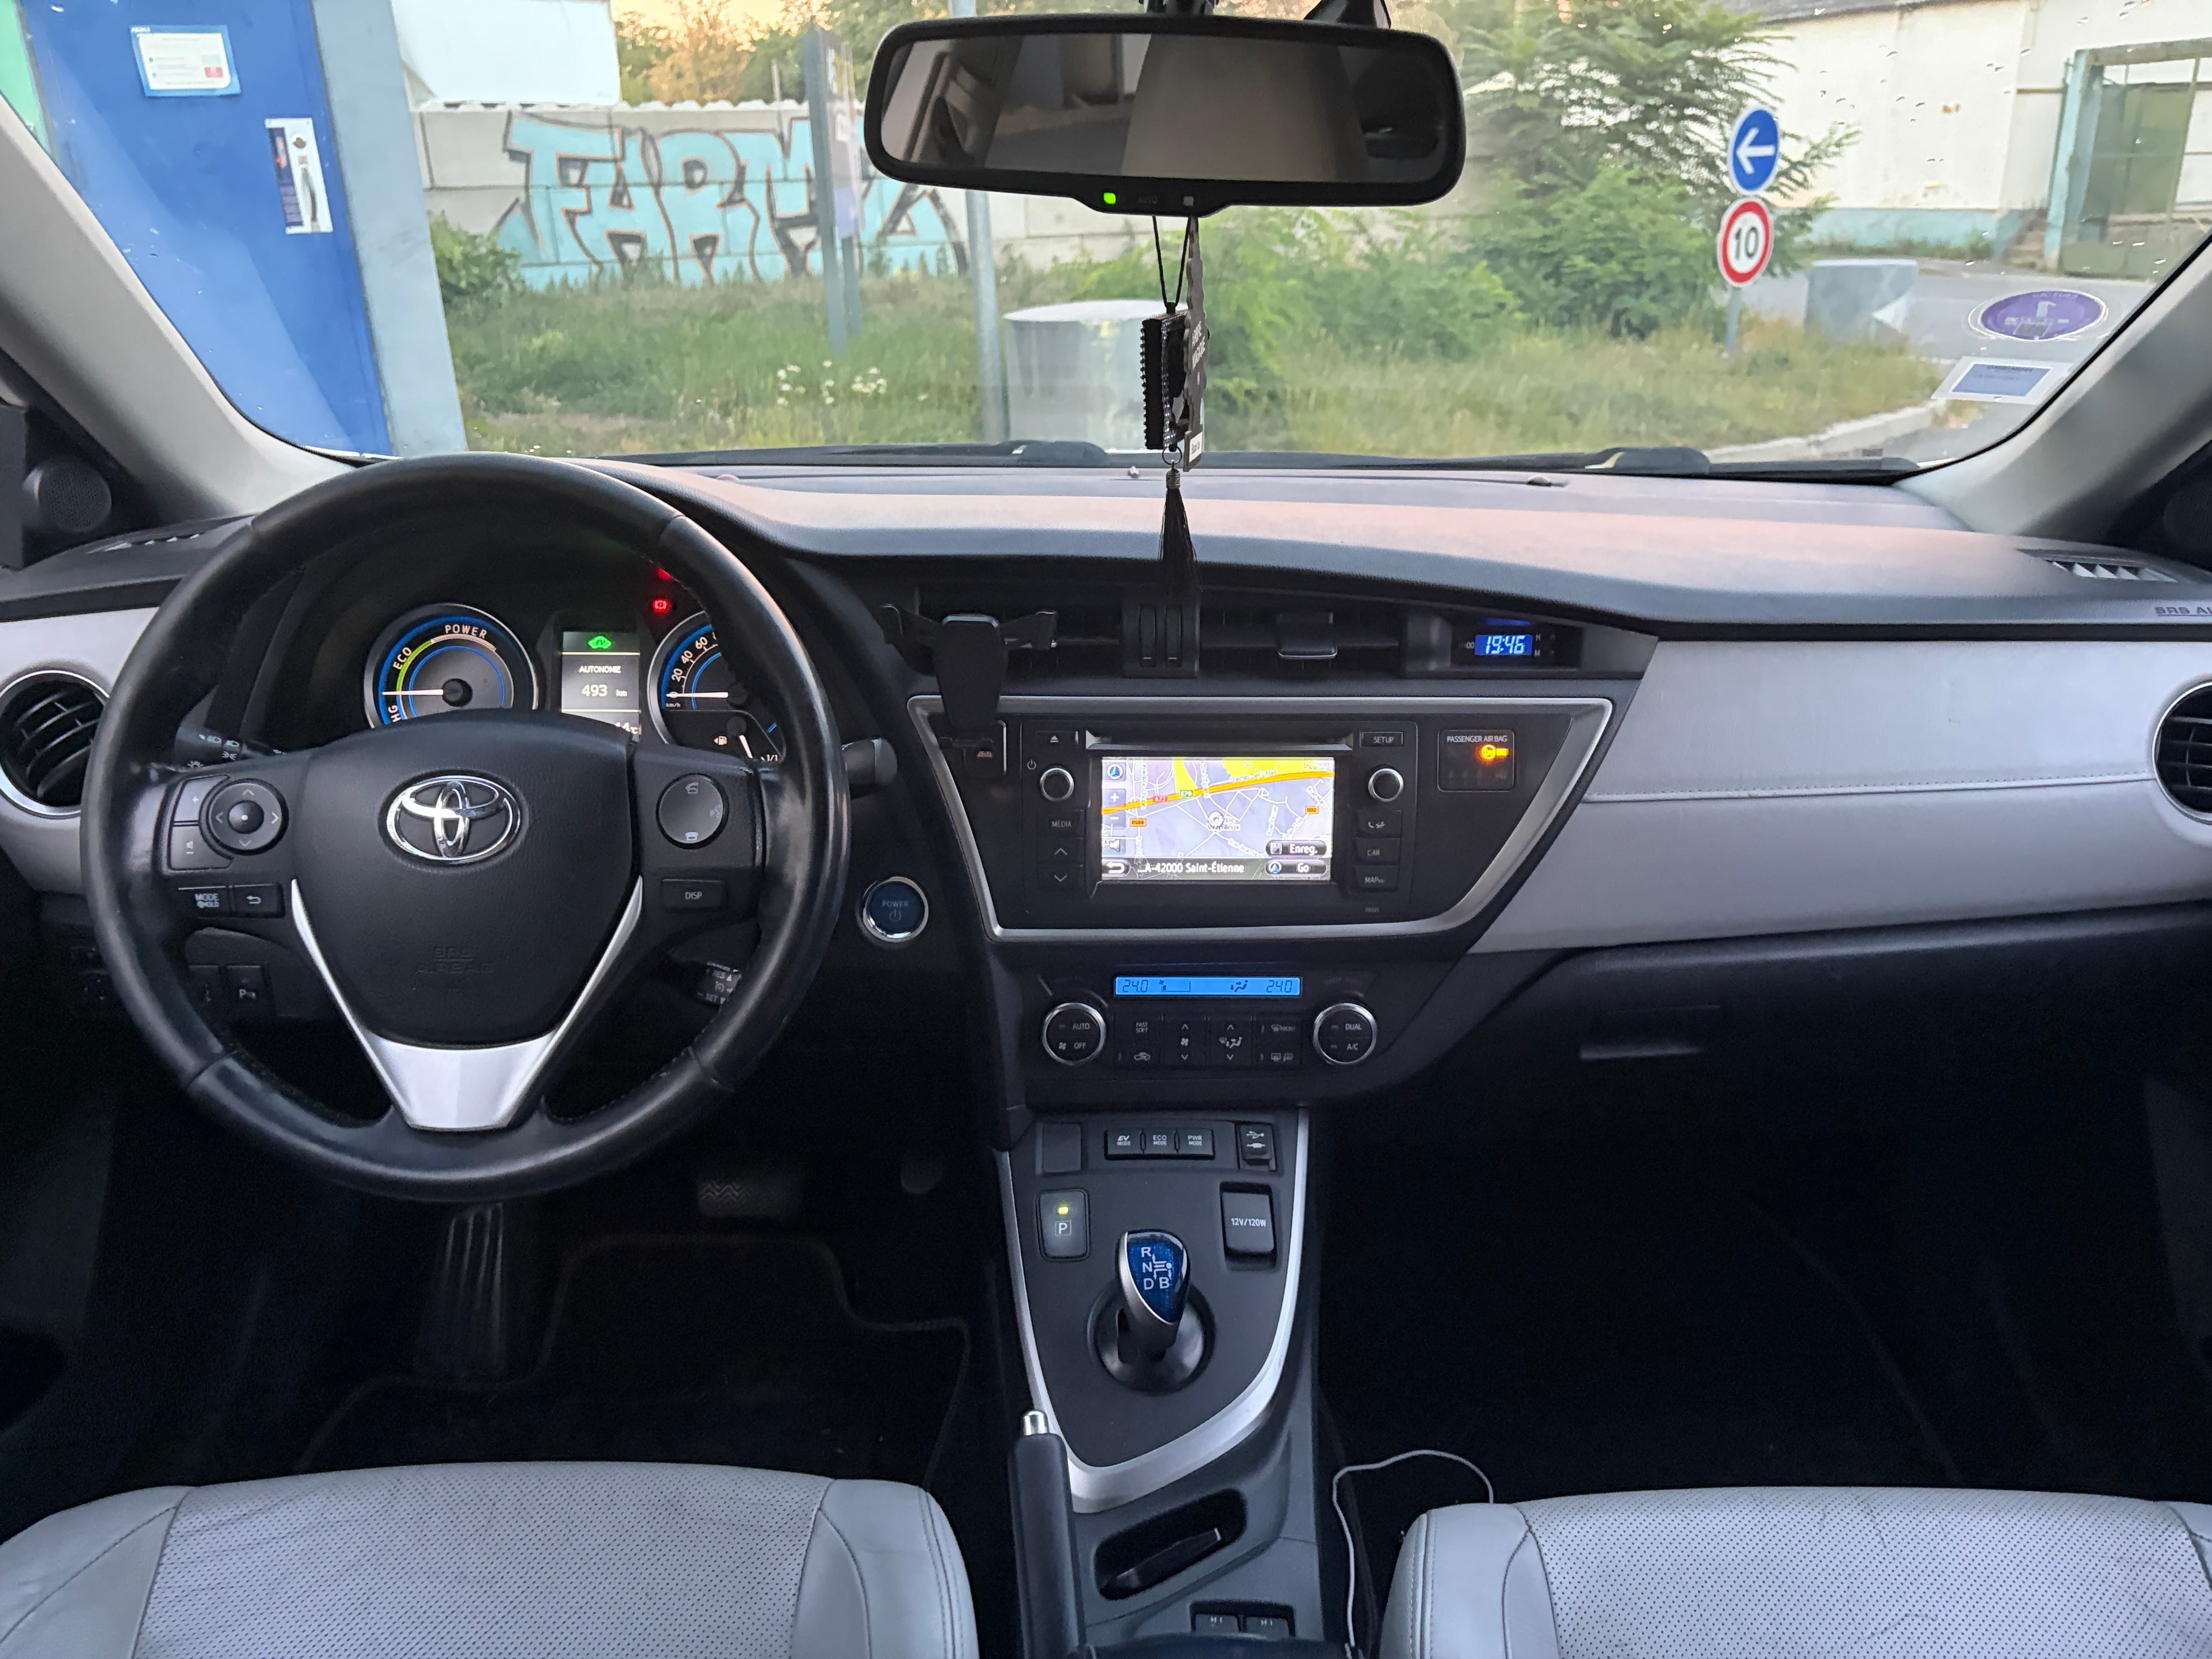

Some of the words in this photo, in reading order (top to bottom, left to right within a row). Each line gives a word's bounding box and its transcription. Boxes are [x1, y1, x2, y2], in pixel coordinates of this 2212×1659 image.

[1732, 226, 1760, 259] 10
[444, 624, 488, 639] POWER
[695, 636, 708, 650] 60
[1486, 635, 1526, 654] 19:46
[392, 646, 412, 670] ECO
[681, 650, 693, 664] 40
[671, 668, 683, 682] 20
[581, 684, 608, 697] 493
[1290, 845, 1318, 856] Enreg.
[1185, 861, 1245, 874] Saint-Étienne
[1297, 862, 1310, 873] Go
[195, 893, 219, 901] MODE
[685, 891, 702, 900] DISP
[1123, 979, 1149, 993] 24.0
[1266, 979, 1293, 993] 24.0
[1059, 1222, 1068, 1235] P
[1231, 1218, 1266, 1228] 12V/120W
[1141, 1247, 1152, 1257] R
[1142, 1262, 1152, 1273] N
[1143, 1278, 1154, 1290] D
[1159, 1277, 1170, 1289] B
